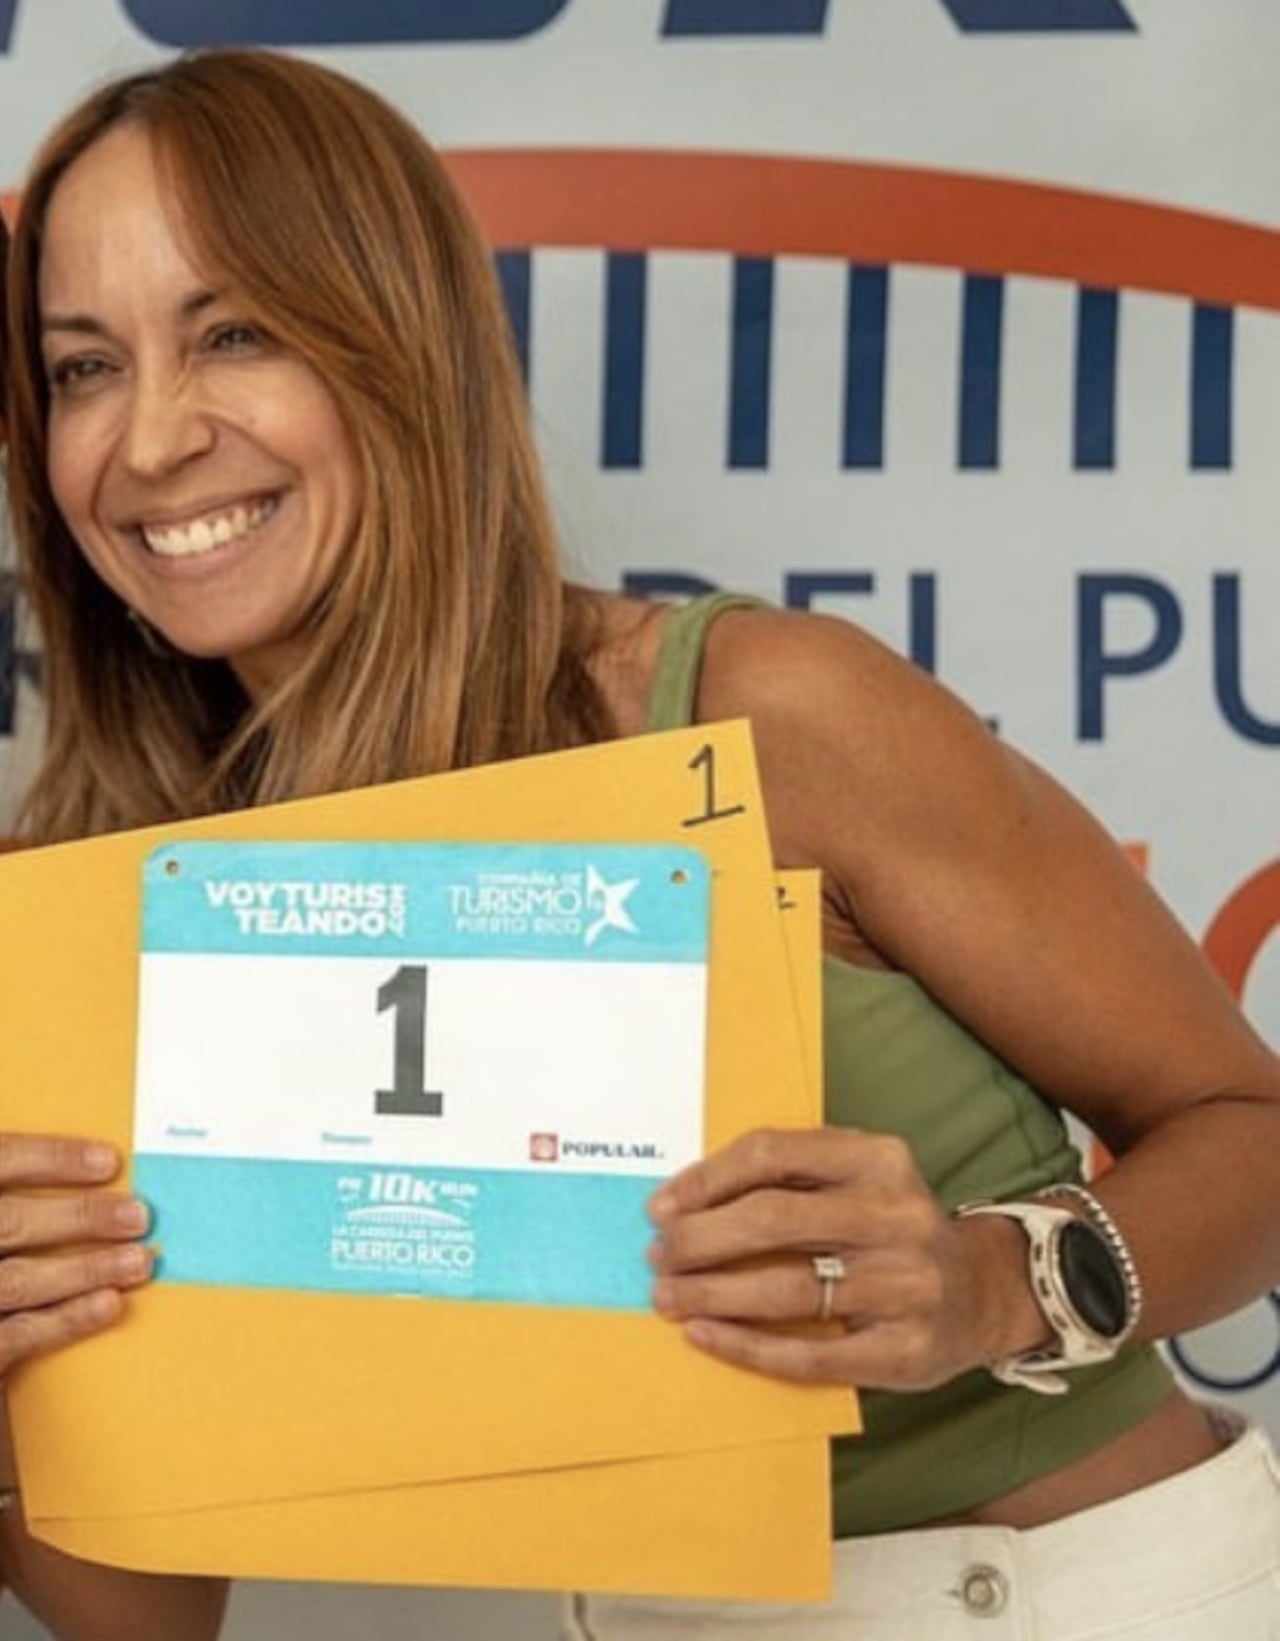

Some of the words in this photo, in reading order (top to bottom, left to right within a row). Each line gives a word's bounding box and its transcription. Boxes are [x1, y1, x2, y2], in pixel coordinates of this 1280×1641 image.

[681, 743, 746, 828] 1
[448, 884, 583, 916] TURISMO
[234, 907, 386, 937] TEANDO
[373, 964, 444, 1118] 1
[370, 1171, 438, 1203] 10K
[331, 1238, 414, 1264] PUERTO
[417, 1243, 475, 1268] RICO
